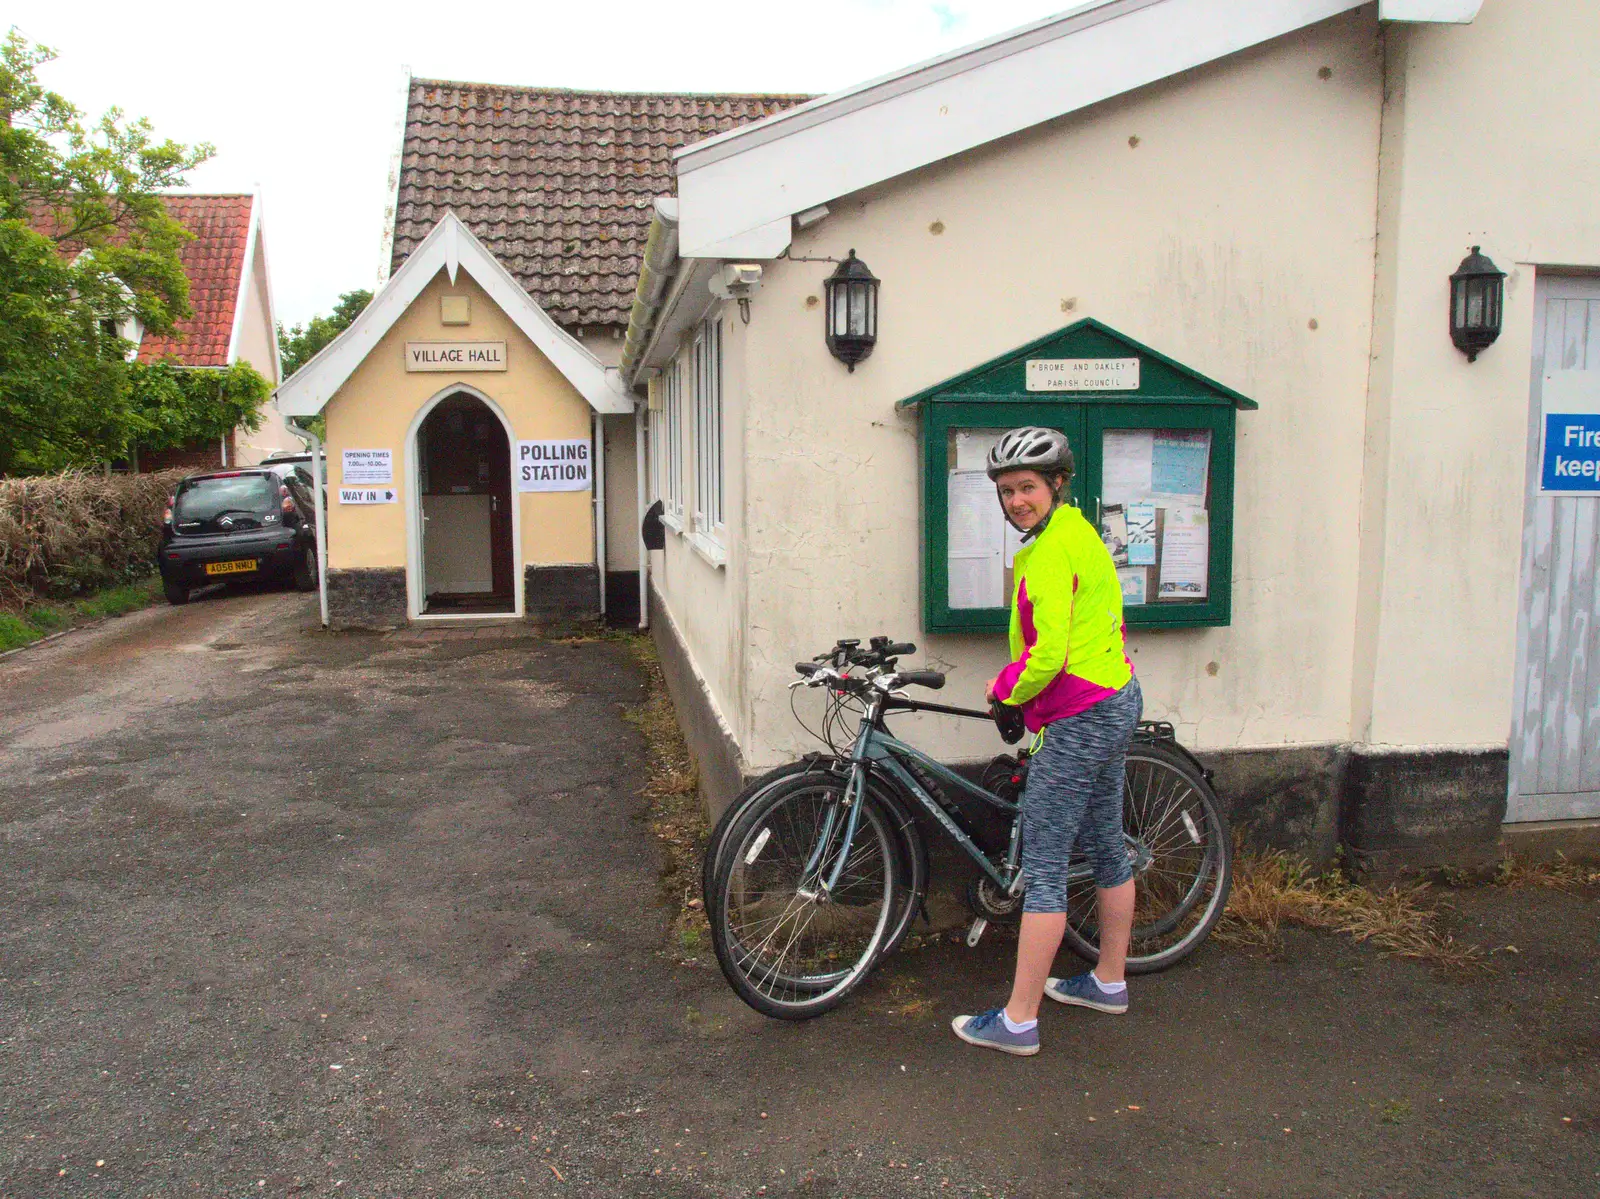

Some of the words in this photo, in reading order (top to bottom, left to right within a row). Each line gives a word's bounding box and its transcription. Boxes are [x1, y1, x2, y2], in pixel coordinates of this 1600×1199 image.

[412, 349, 463, 362] VILLAGE
[469, 349, 501, 362] HALL
[1038, 363, 1065, 372] BROME
[1073, 363, 1089, 371] AND
[1094, 362, 1126, 370] OAKLEY
[1047, 379, 1079, 387] PARISH
[1084, 378, 1121, 387] COUNCIL
[520, 444, 588, 460] POLLING
[522, 464, 587, 481] STATION
[342, 491, 363, 501] WAY
[366, 491, 377, 501] IN
[911, 787, 966, 842] MARIN
